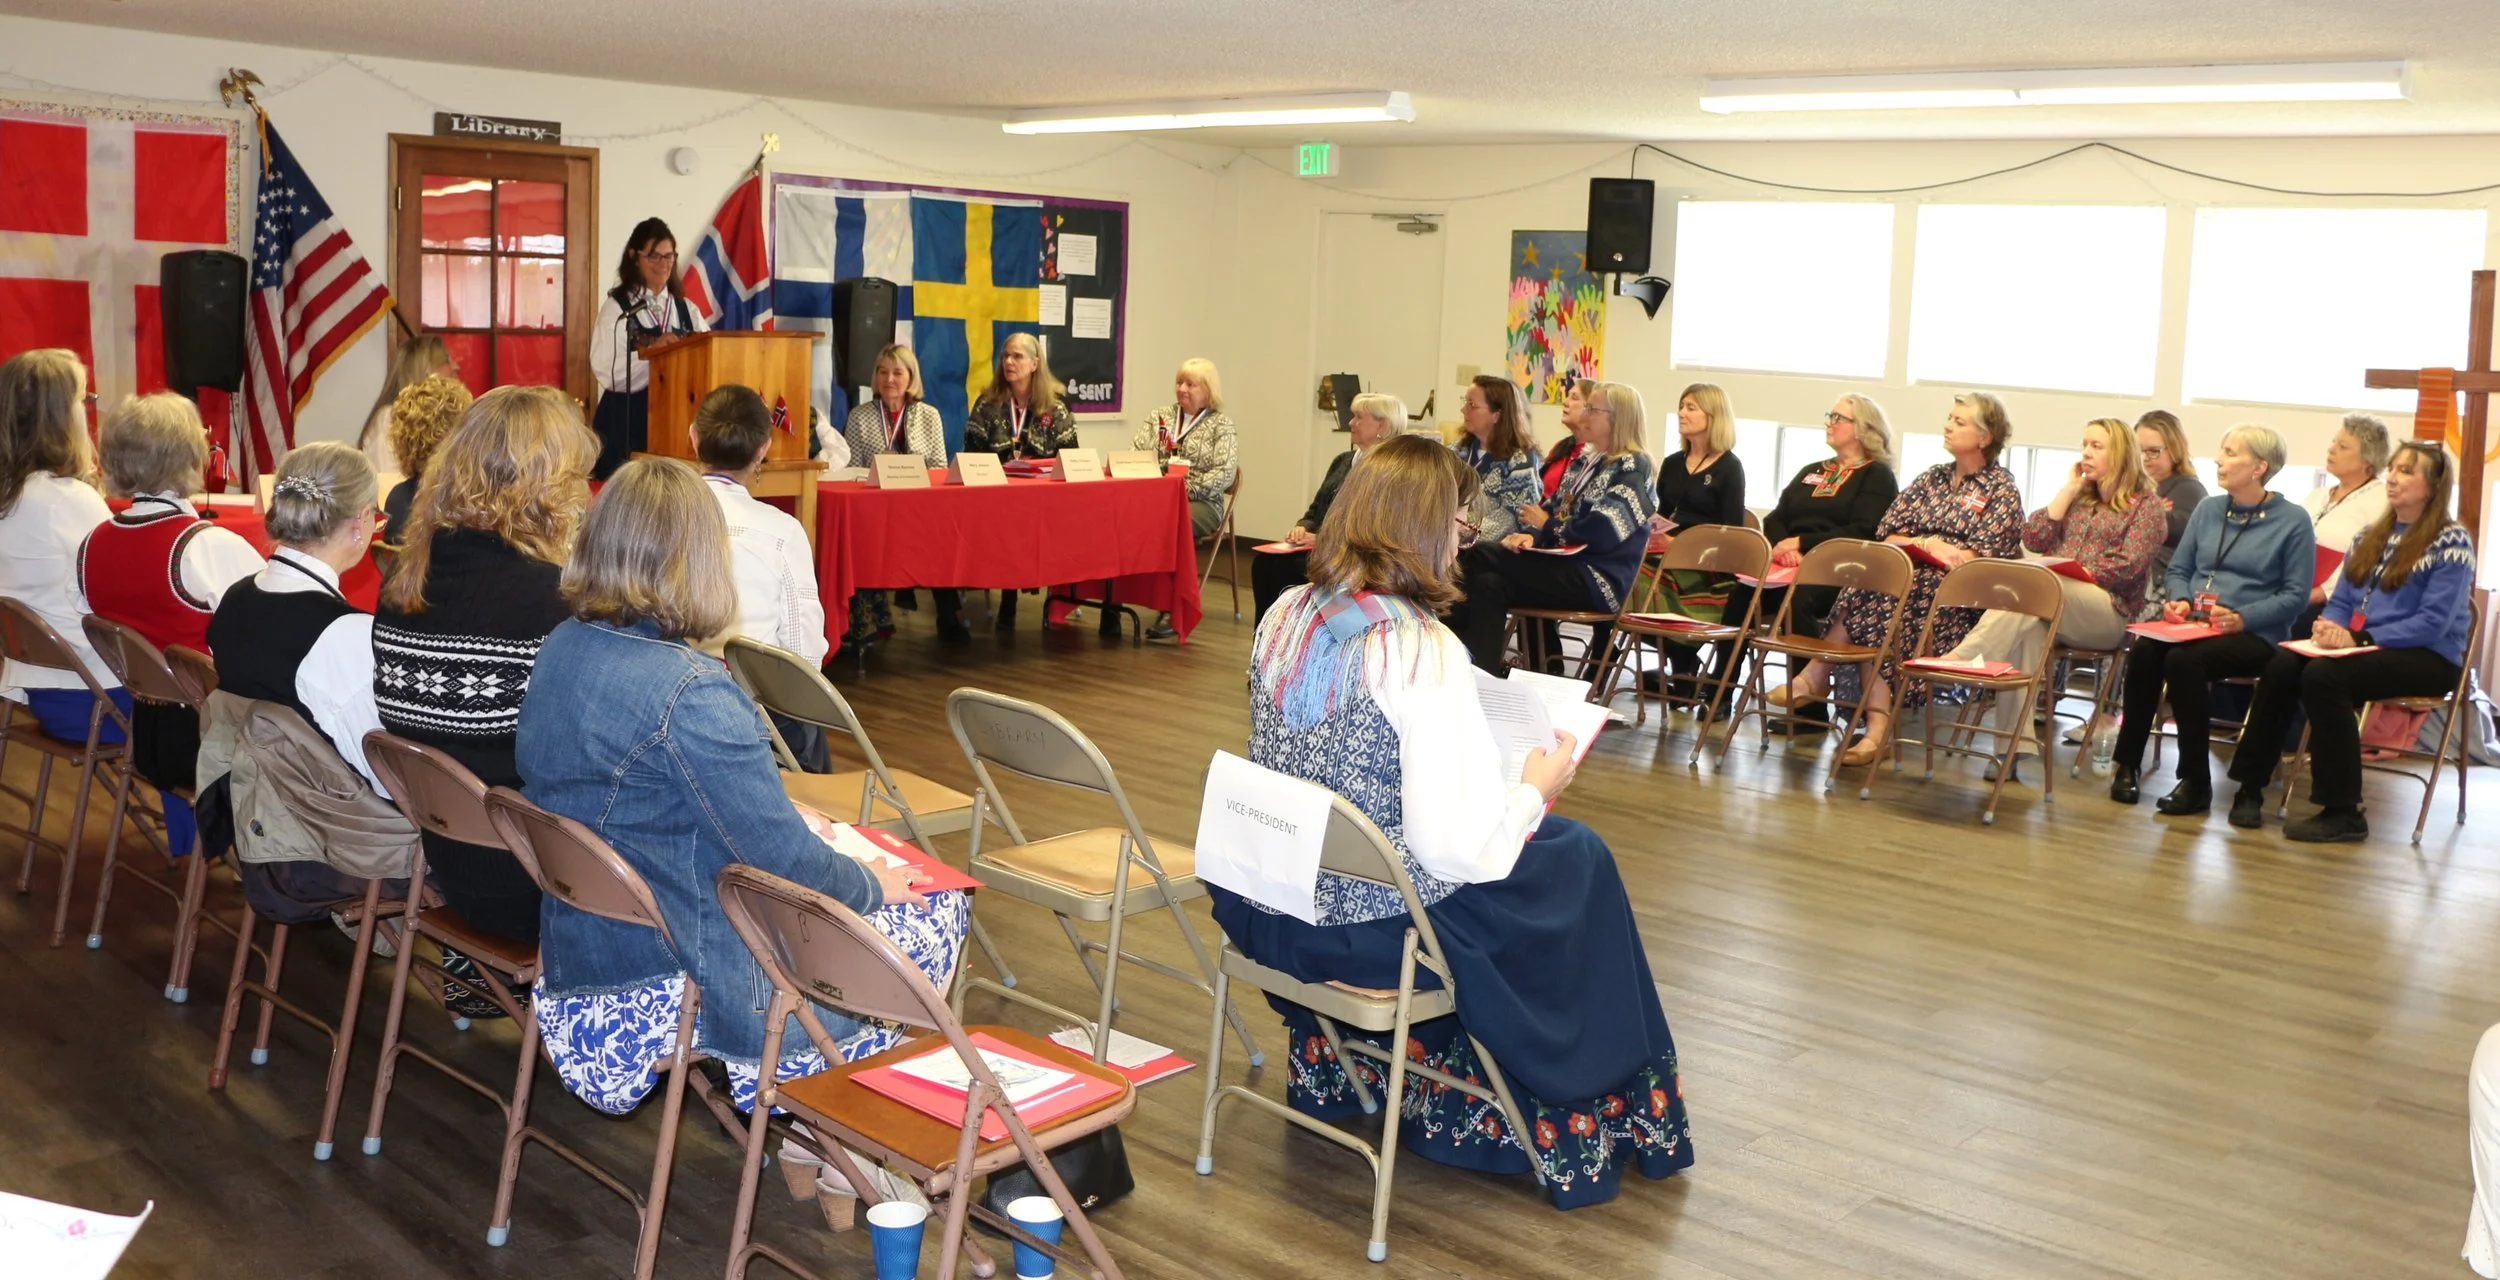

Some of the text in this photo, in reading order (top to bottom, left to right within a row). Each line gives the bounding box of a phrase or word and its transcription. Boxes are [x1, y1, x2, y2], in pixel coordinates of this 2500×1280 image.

[451, 117, 546, 140] Library
[1299, 144, 1330, 175] EXIT
[1068, 379, 1113, 401] & SENT
[1226, 798, 1298, 836] VICE-PRESIDENT
